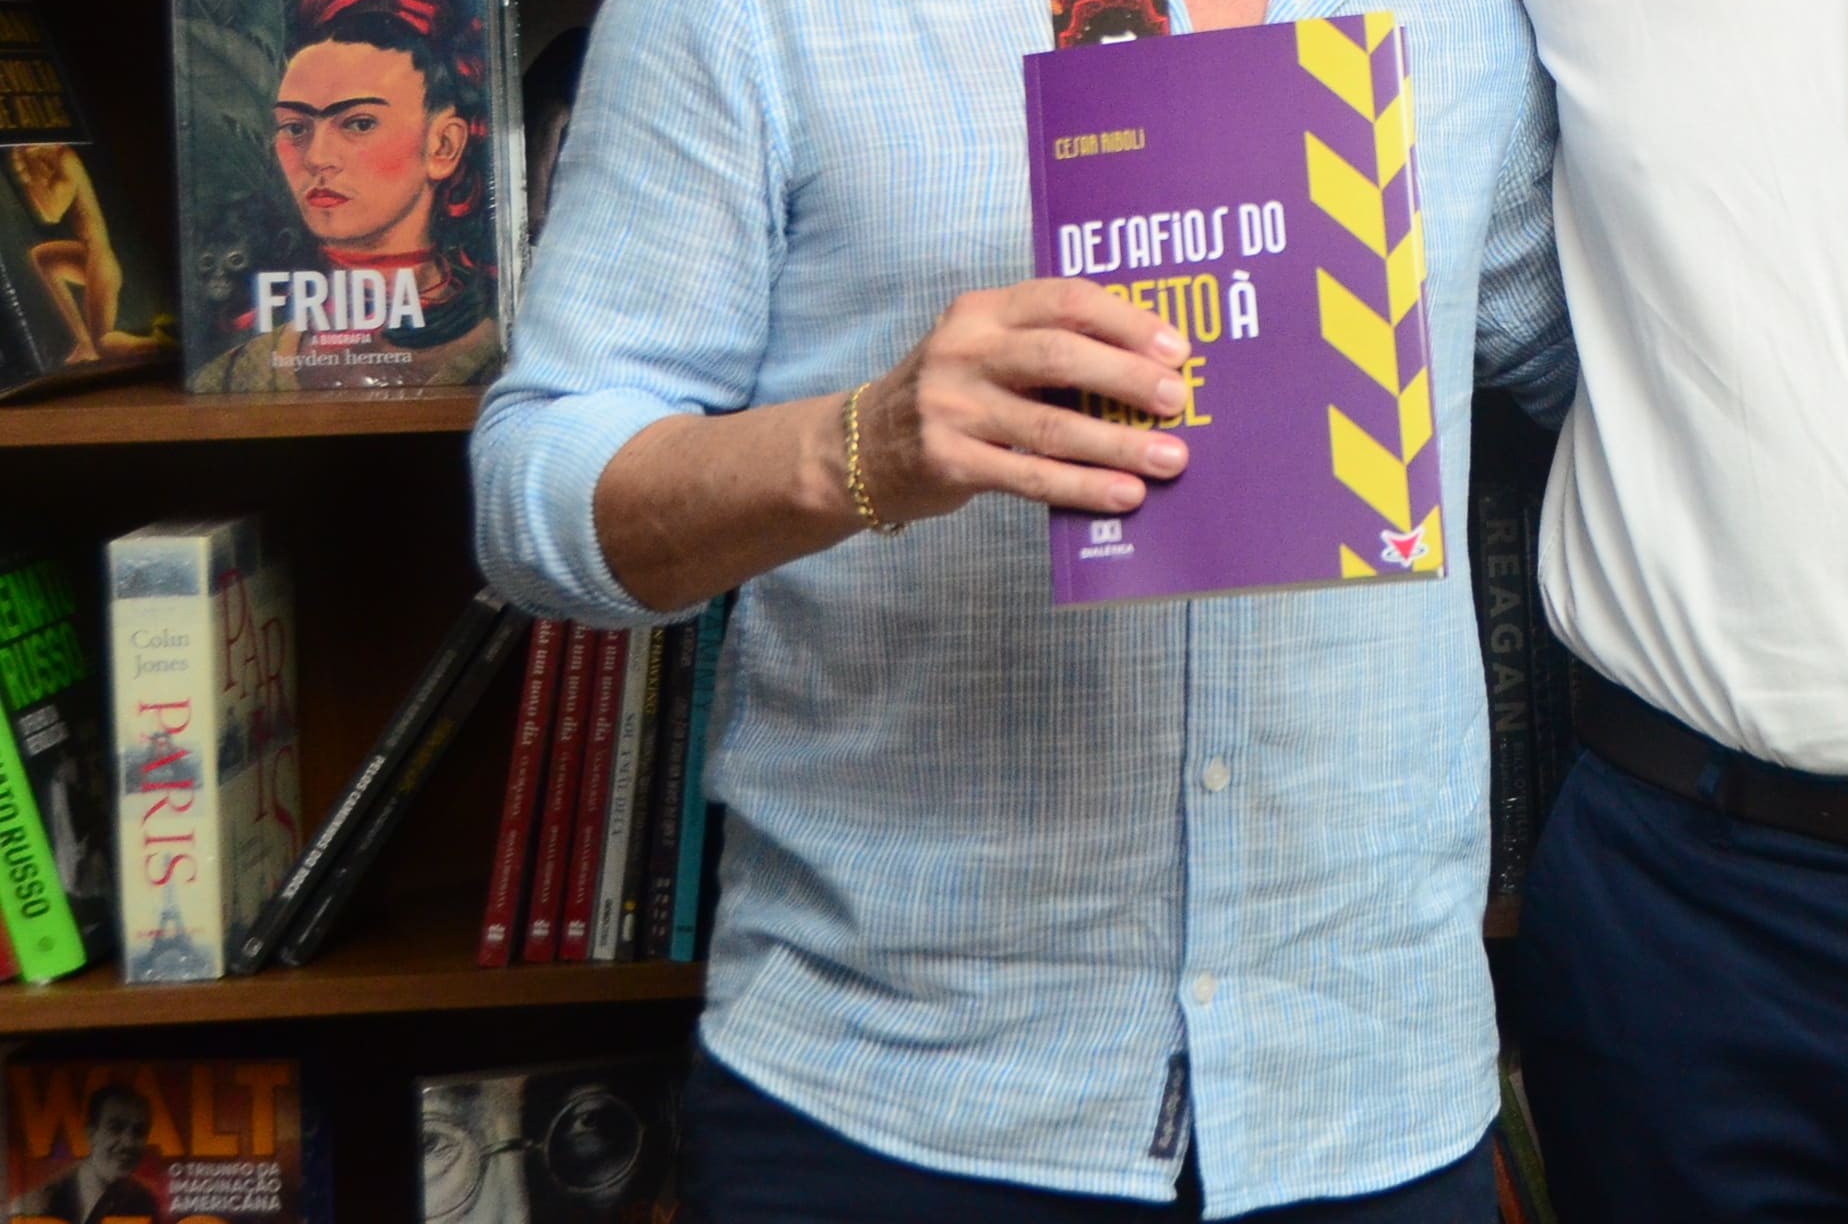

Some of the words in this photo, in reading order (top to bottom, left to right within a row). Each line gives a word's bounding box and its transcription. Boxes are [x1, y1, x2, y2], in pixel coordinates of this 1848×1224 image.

[1055, 132, 1099, 161] CESAR
[1239, 201, 1287, 257] DO
[258, 268, 426, 333] FRIDA
[1228, 270, 1260, 341] À
[321, 332, 371, 344] BIOGRAFIA
[272, 349, 340, 370] hayden
[345, 347, 413, 365] herrera
[129, 629, 191, 650] Colin
[1486, 518, 1530, 734] REAGAN
[134, 654, 190, 678] Jones
[519, 720, 539, 747] dia
[560, 716, 577, 742] dia
[137, 698, 198, 889] PARIS
[2, 823, 51, 919] RUSSO
[169, 1177, 282, 1195] IMAGINAÇÃO
[169, 1196, 282, 1214] AMERICANA
